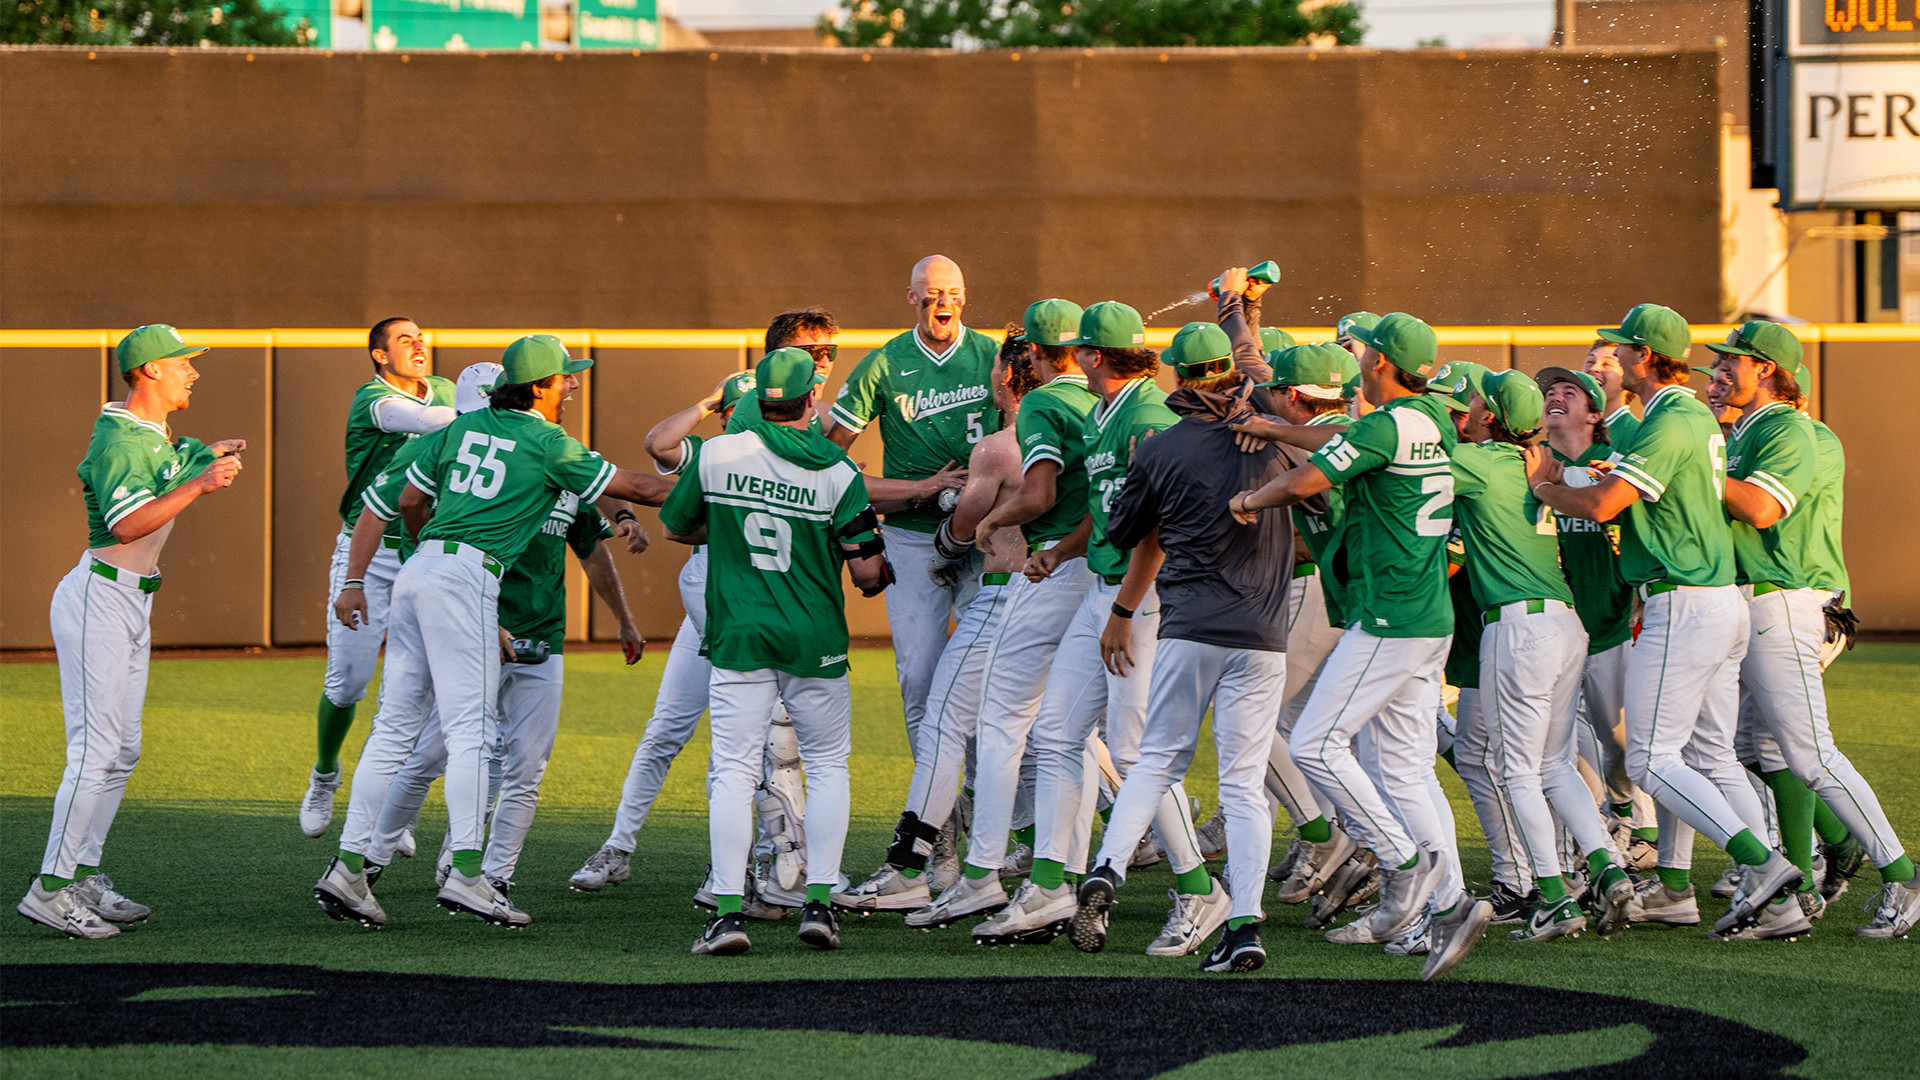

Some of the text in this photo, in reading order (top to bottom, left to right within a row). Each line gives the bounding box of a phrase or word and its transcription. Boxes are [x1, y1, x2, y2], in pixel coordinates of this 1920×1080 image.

[1825, 0, 1920, 32] WOL
[1808, 94, 1920, 138] PER
[894, 384, 988, 421] Wolverines
[966, 411, 983, 443] 5
[449, 430, 517, 500] 55
[1317, 433, 1360, 471] 25
[726, 473, 816, 506] IVERSON
[743, 511, 792, 573] 9
